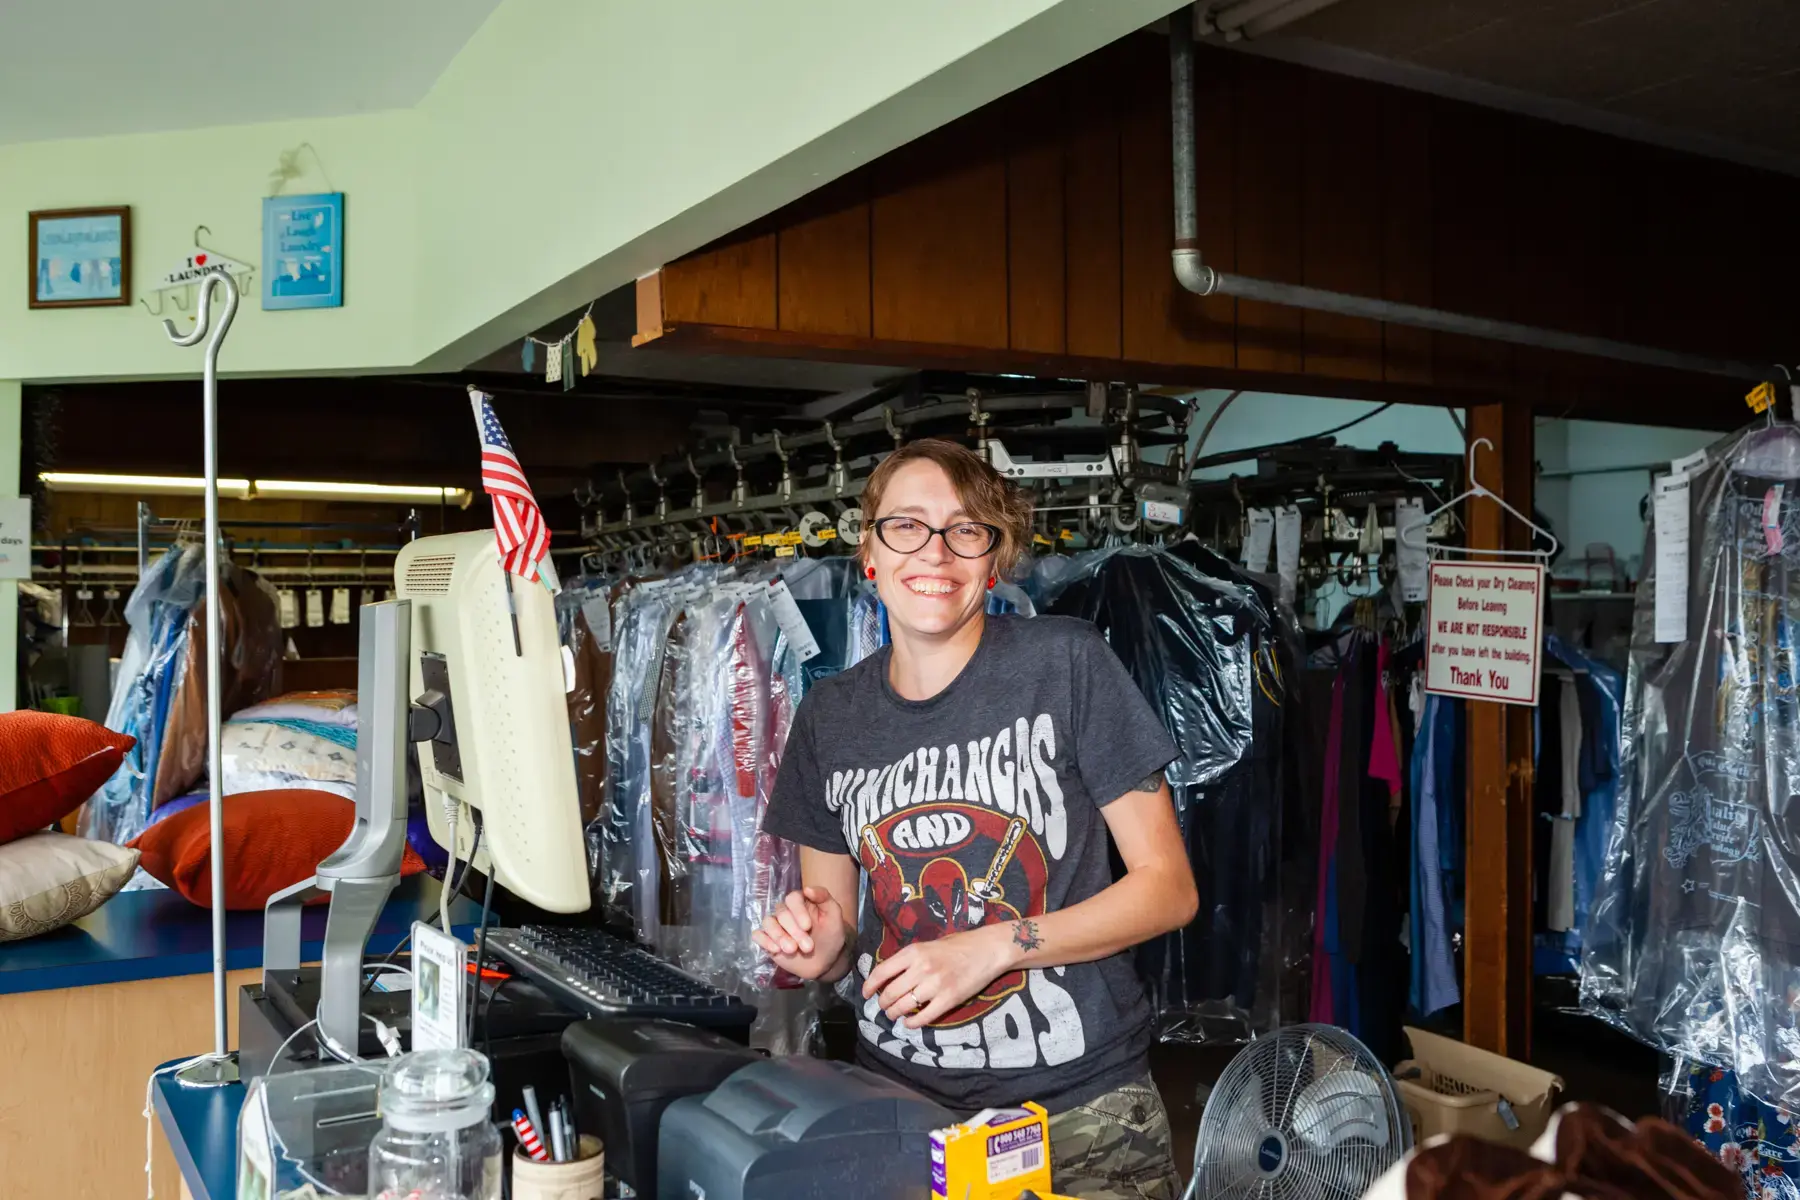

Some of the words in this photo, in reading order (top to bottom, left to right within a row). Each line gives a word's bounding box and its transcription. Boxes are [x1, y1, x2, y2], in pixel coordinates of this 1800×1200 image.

[187, 257, 193, 268] I
[1434, 574, 1453, 588] Please
[1456, 574, 1474, 588] Check
[1477, 578, 1491, 591] your
[1494, 576, 1505, 592] Dry
[1508, 577, 1535, 594] Cleaning
[1457, 597, 1479, 611] Before
[1482, 598, 1507, 616] Leaving
[1438, 621, 1448, 633] WE
[1450, 621, 1463, 635] ARE
[1466, 623, 1479, 635] NOT
[1482, 624, 1527, 640] RESPONSIBLE
[1432, 643, 1445, 654] after
[1448, 645, 1459, 657] you
[1461, 644, 1476, 657] have
[1478, 646, 1490, 658] left
[1491, 647, 1502, 660] the
[1450, 666, 1482, 687] Thank
[1489, 669, 1509, 690] You
[893, 813, 971, 849] AND
